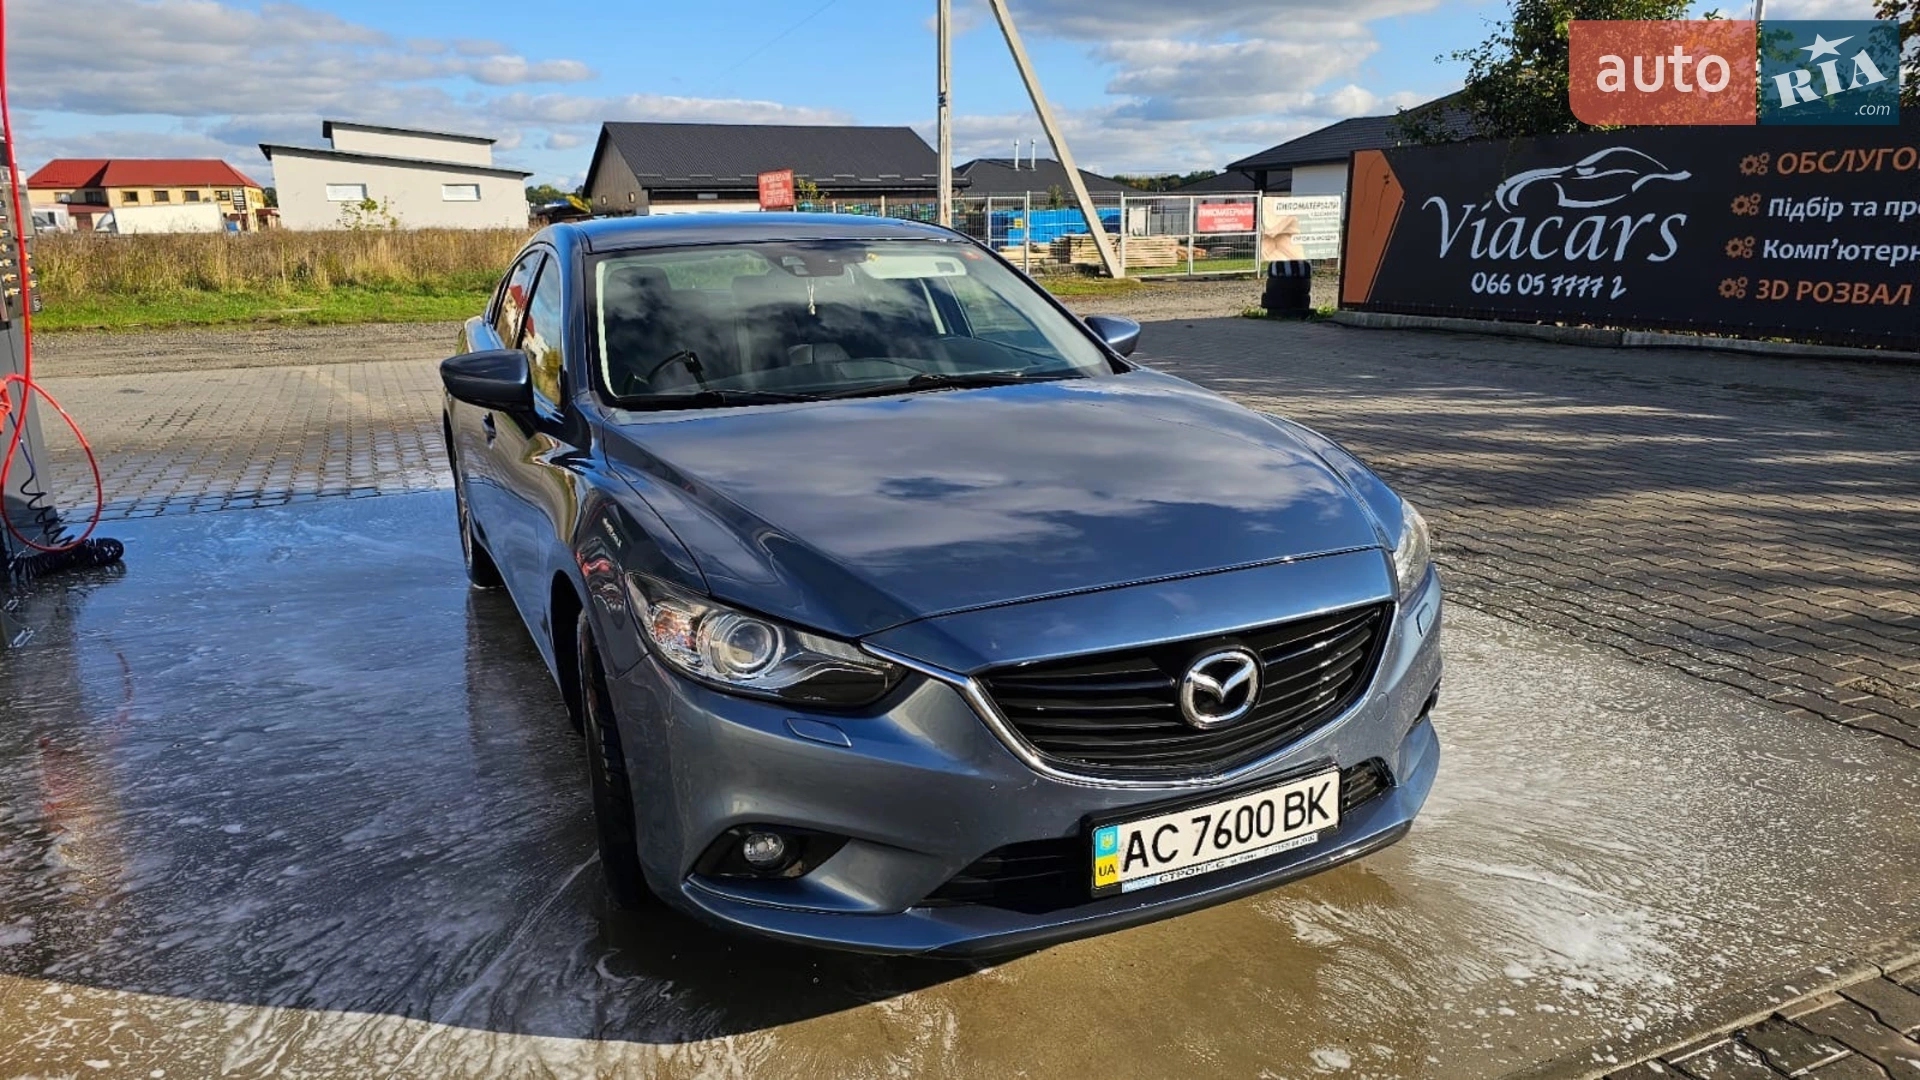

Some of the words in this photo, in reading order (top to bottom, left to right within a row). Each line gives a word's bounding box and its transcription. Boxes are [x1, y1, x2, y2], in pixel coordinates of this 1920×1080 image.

[1777, 146, 1920, 175] ОБСЛУГО
[1768, 197, 1844, 222] Підбір
[1851, 201, 1877, 217] та
[1884, 200, 1920, 222] пр
[1422, 196, 1687, 263] Viacars
[1470, 272, 1512, 296] 066
[1517, 274, 1545, 297] 05
[1551, 276, 1605, 299] 7777
[1609, 275, 1628, 301] 2
[1756, 279, 1789, 300] 3D
[1796, 280, 1913, 305] РОЗВАЛ
[1122, 823, 1180, 873] AC
[1191, 798, 1275, 857] 7600
[1283, 781, 1332, 833] BK
[1098, 864, 1116, 878] UA
